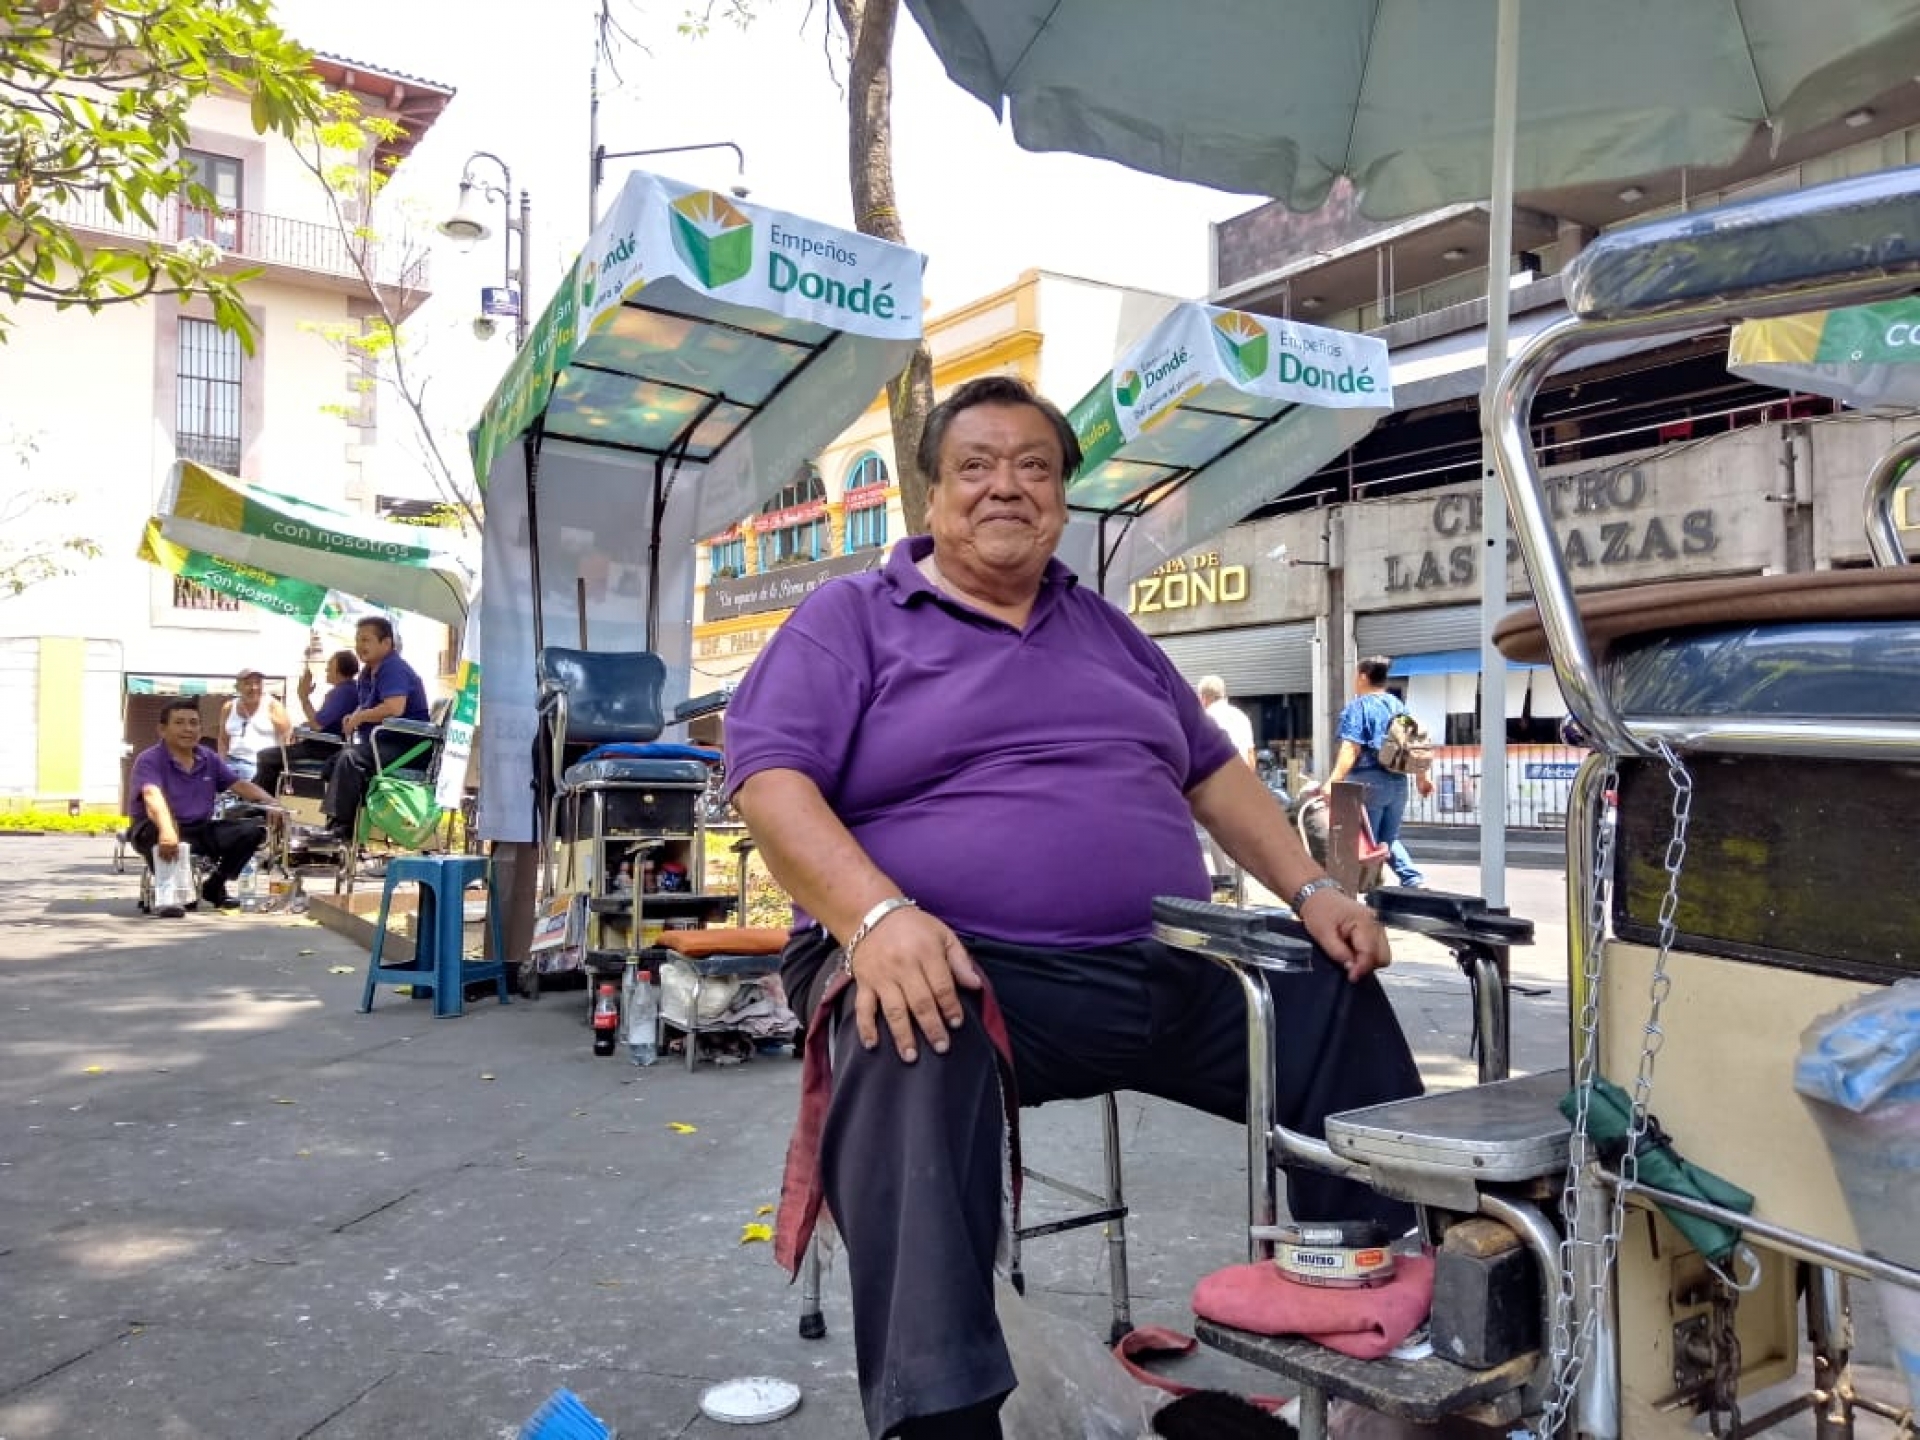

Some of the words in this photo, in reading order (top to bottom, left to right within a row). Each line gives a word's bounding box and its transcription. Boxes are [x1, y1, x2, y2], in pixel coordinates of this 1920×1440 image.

[770, 224, 857, 267] Empeños
[768, 250, 895, 320] Dondé
[1280, 330, 1343, 357] Empeños
[1144, 344, 1188, 389] Dondé
[1278, 352, 1376, 394] Dondé
[272, 521, 311, 541] con
[318, 530, 409, 558] nosotros
[1193, 550, 1220, 570] DE
[1385, 545, 1475, 592] LAS
